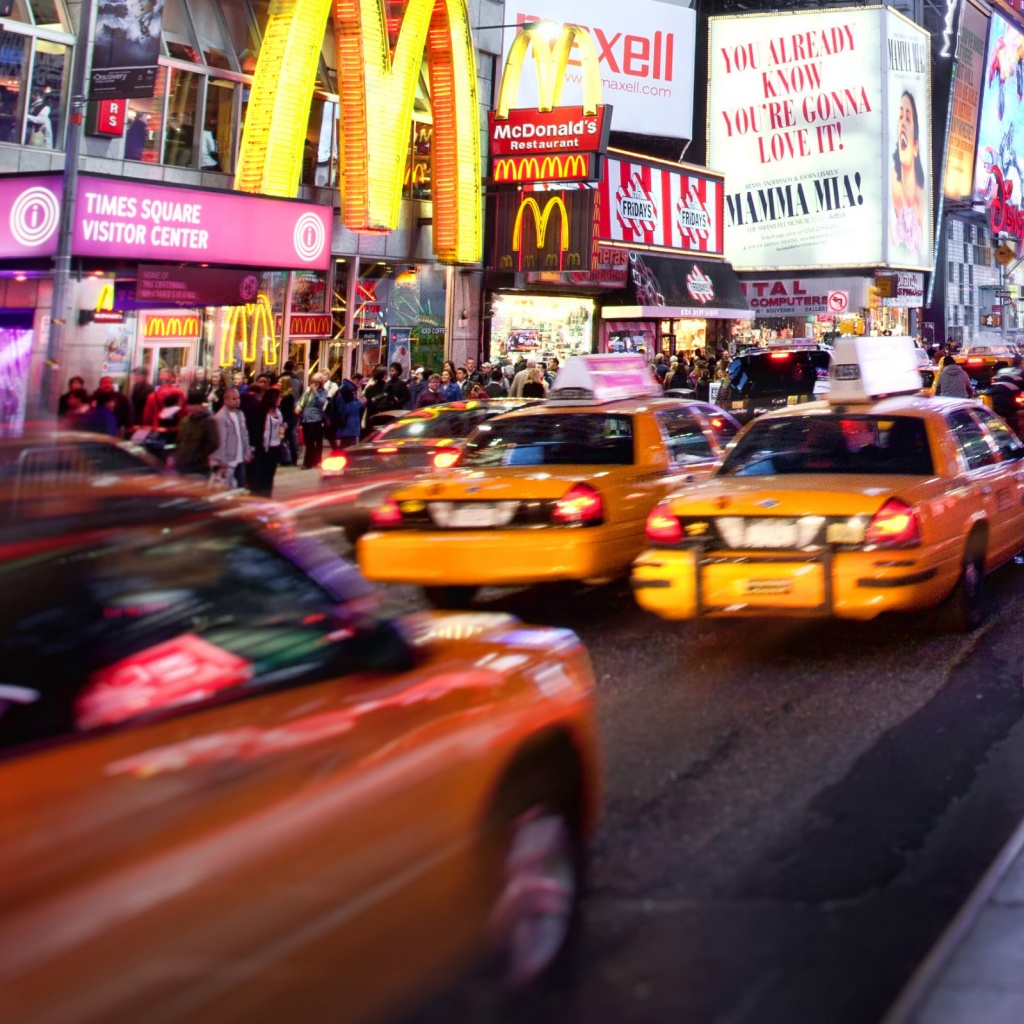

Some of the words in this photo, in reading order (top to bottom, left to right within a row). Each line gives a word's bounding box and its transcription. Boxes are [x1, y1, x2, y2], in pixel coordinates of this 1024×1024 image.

[721, 42, 761, 74] YOU
[767, 23, 856, 66] ALREADY
[887, 38, 911, 72] MAMMA
[762, 61, 823, 99] KNOW
[722, 99, 797, 137] YOU'RE
[802, 86, 872, 124] GONNA
[493, 119, 597, 139] McDonald's
[510, 138, 579, 150] Restaurant
[758, 128, 811, 164] LOVE
[815, 121, 844, 154] IT!
[85, 192, 137, 218] TIMES
[141, 200, 202, 224] SQUARE
[725, 182, 810, 228] MAMMA
[813, 171, 864, 213] MIA!
[83, 219, 146, 245] VISITOR
[151, 226, 208, 249] CENTER
[751, 295, 829, 307] COMPUTERS
[421, 327, 431, 335] ICED
